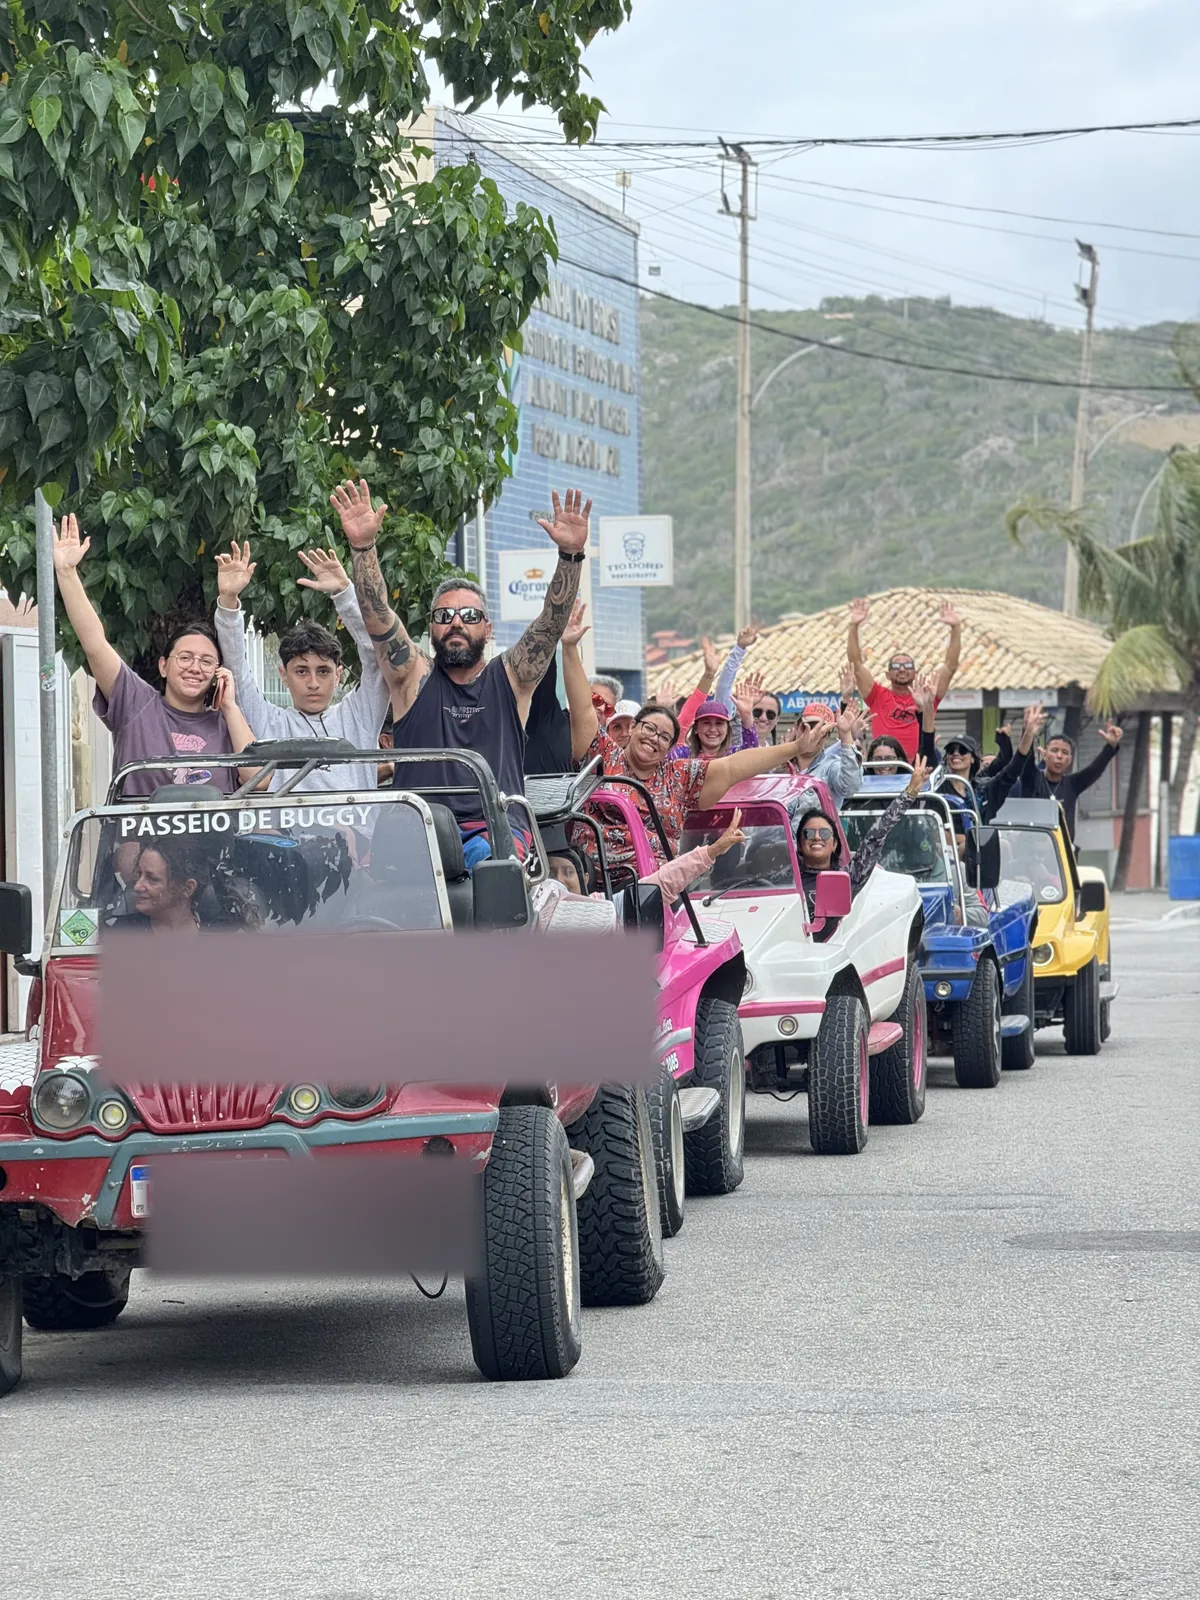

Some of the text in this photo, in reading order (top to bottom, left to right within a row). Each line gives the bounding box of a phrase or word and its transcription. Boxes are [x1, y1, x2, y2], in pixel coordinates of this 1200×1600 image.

[508, 580, 550, 595] Coron
[121, 805, 372, 837] PASSEIO DE BUGGY
